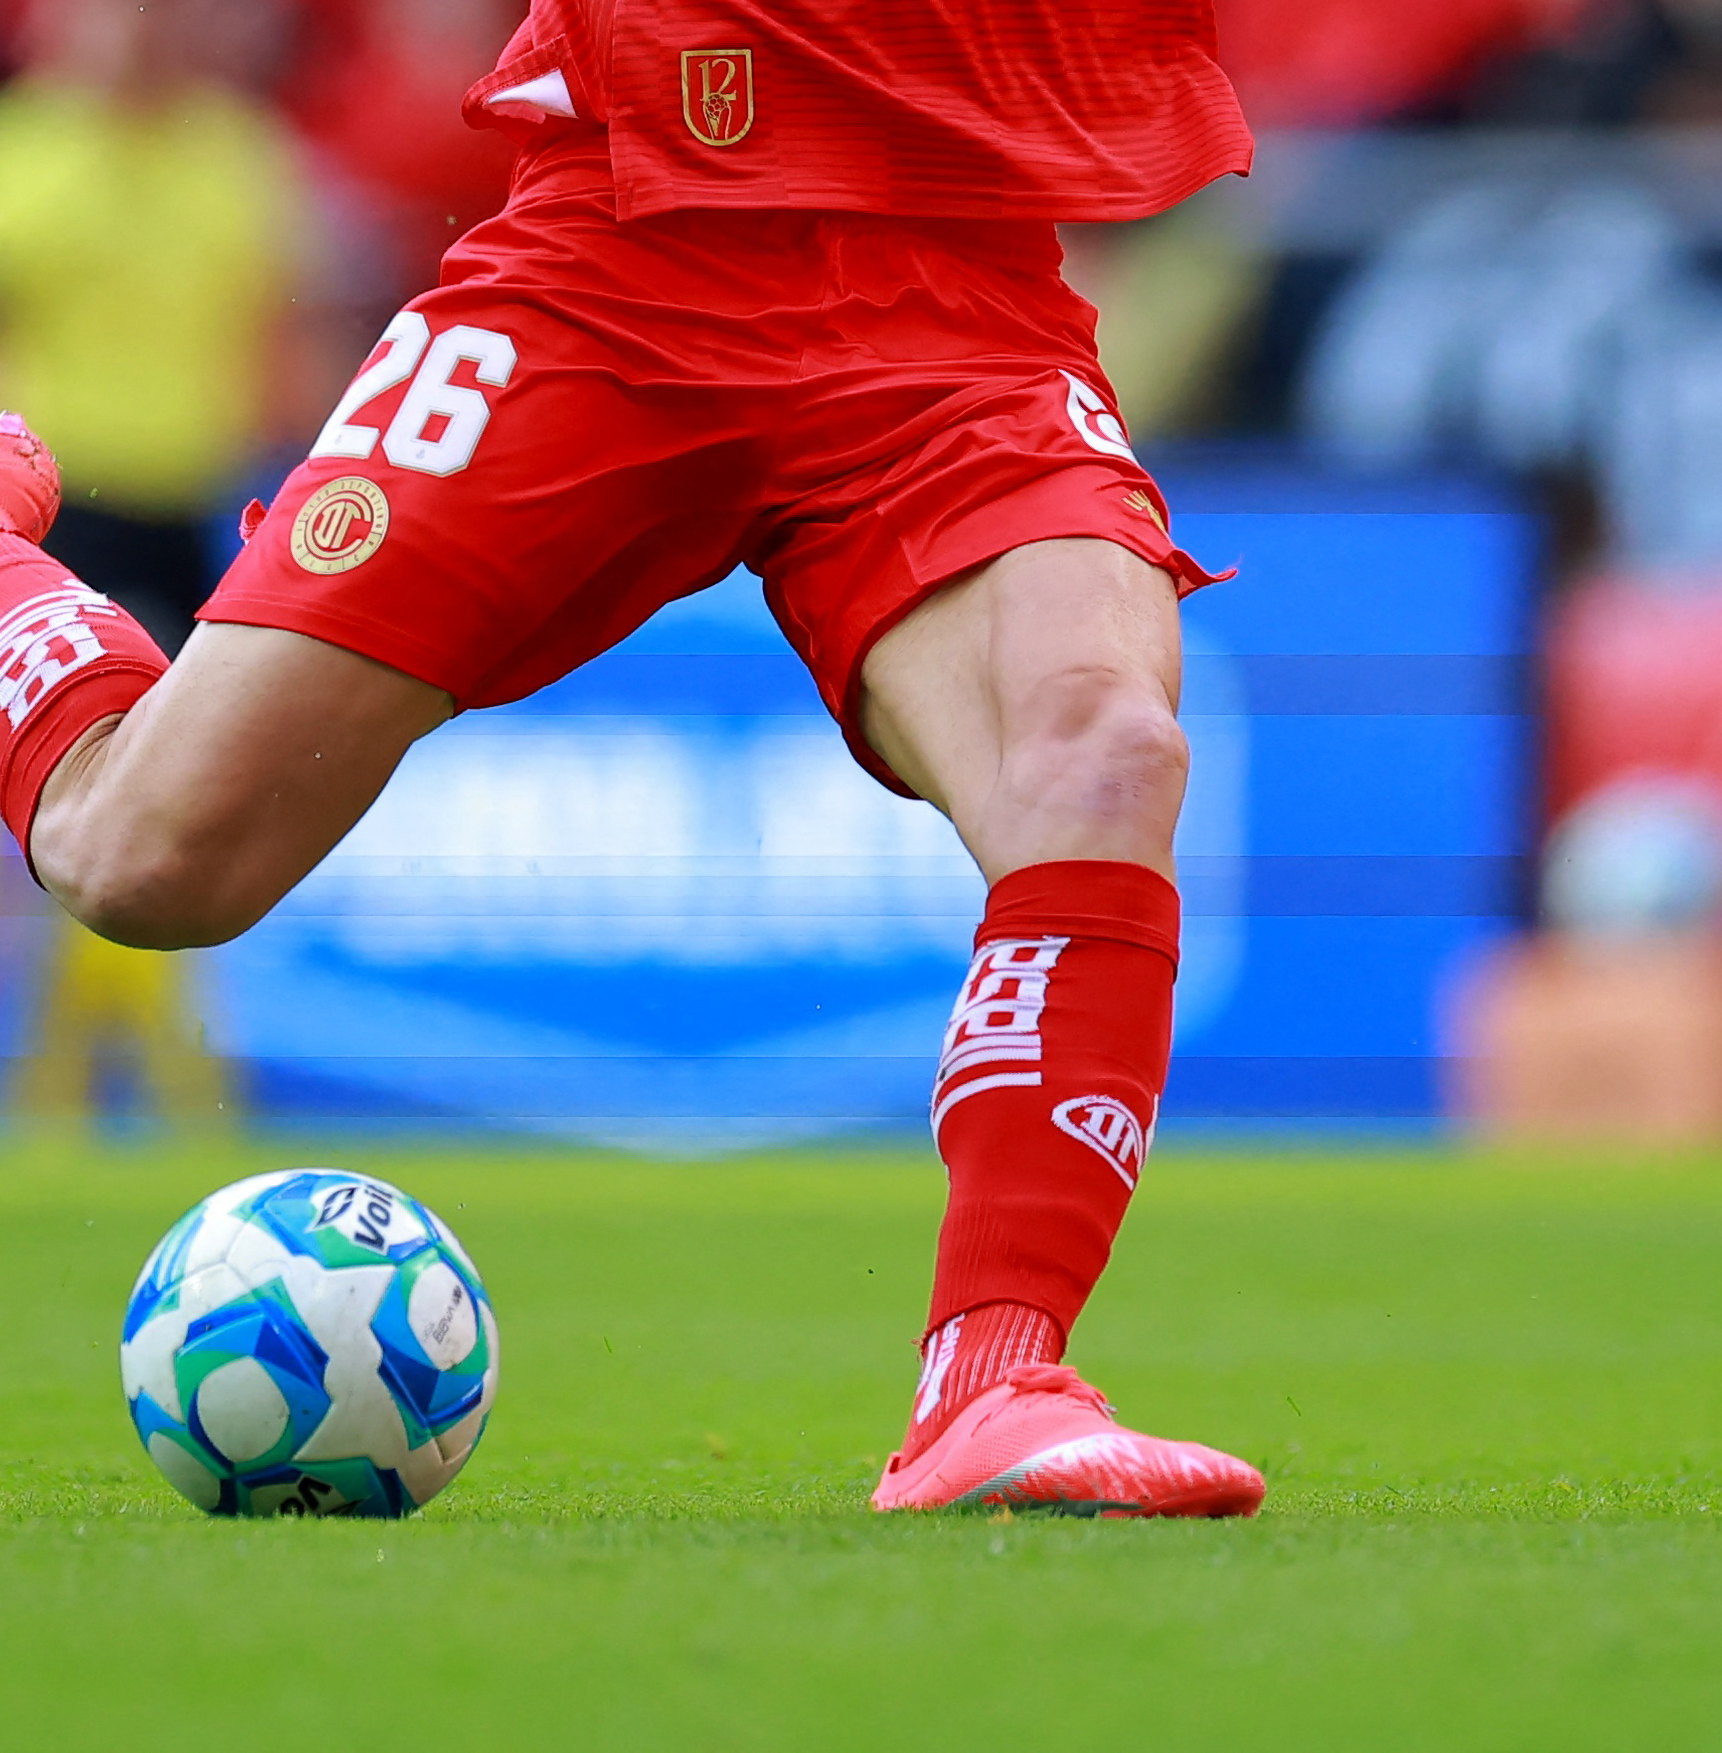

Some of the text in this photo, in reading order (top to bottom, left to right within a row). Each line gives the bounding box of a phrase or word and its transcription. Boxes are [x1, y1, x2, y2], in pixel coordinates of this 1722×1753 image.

[698, 58, 737, 102] 12
[309, 311, 518, 477] 26
[355, 1183, 393, 1251] Voit
